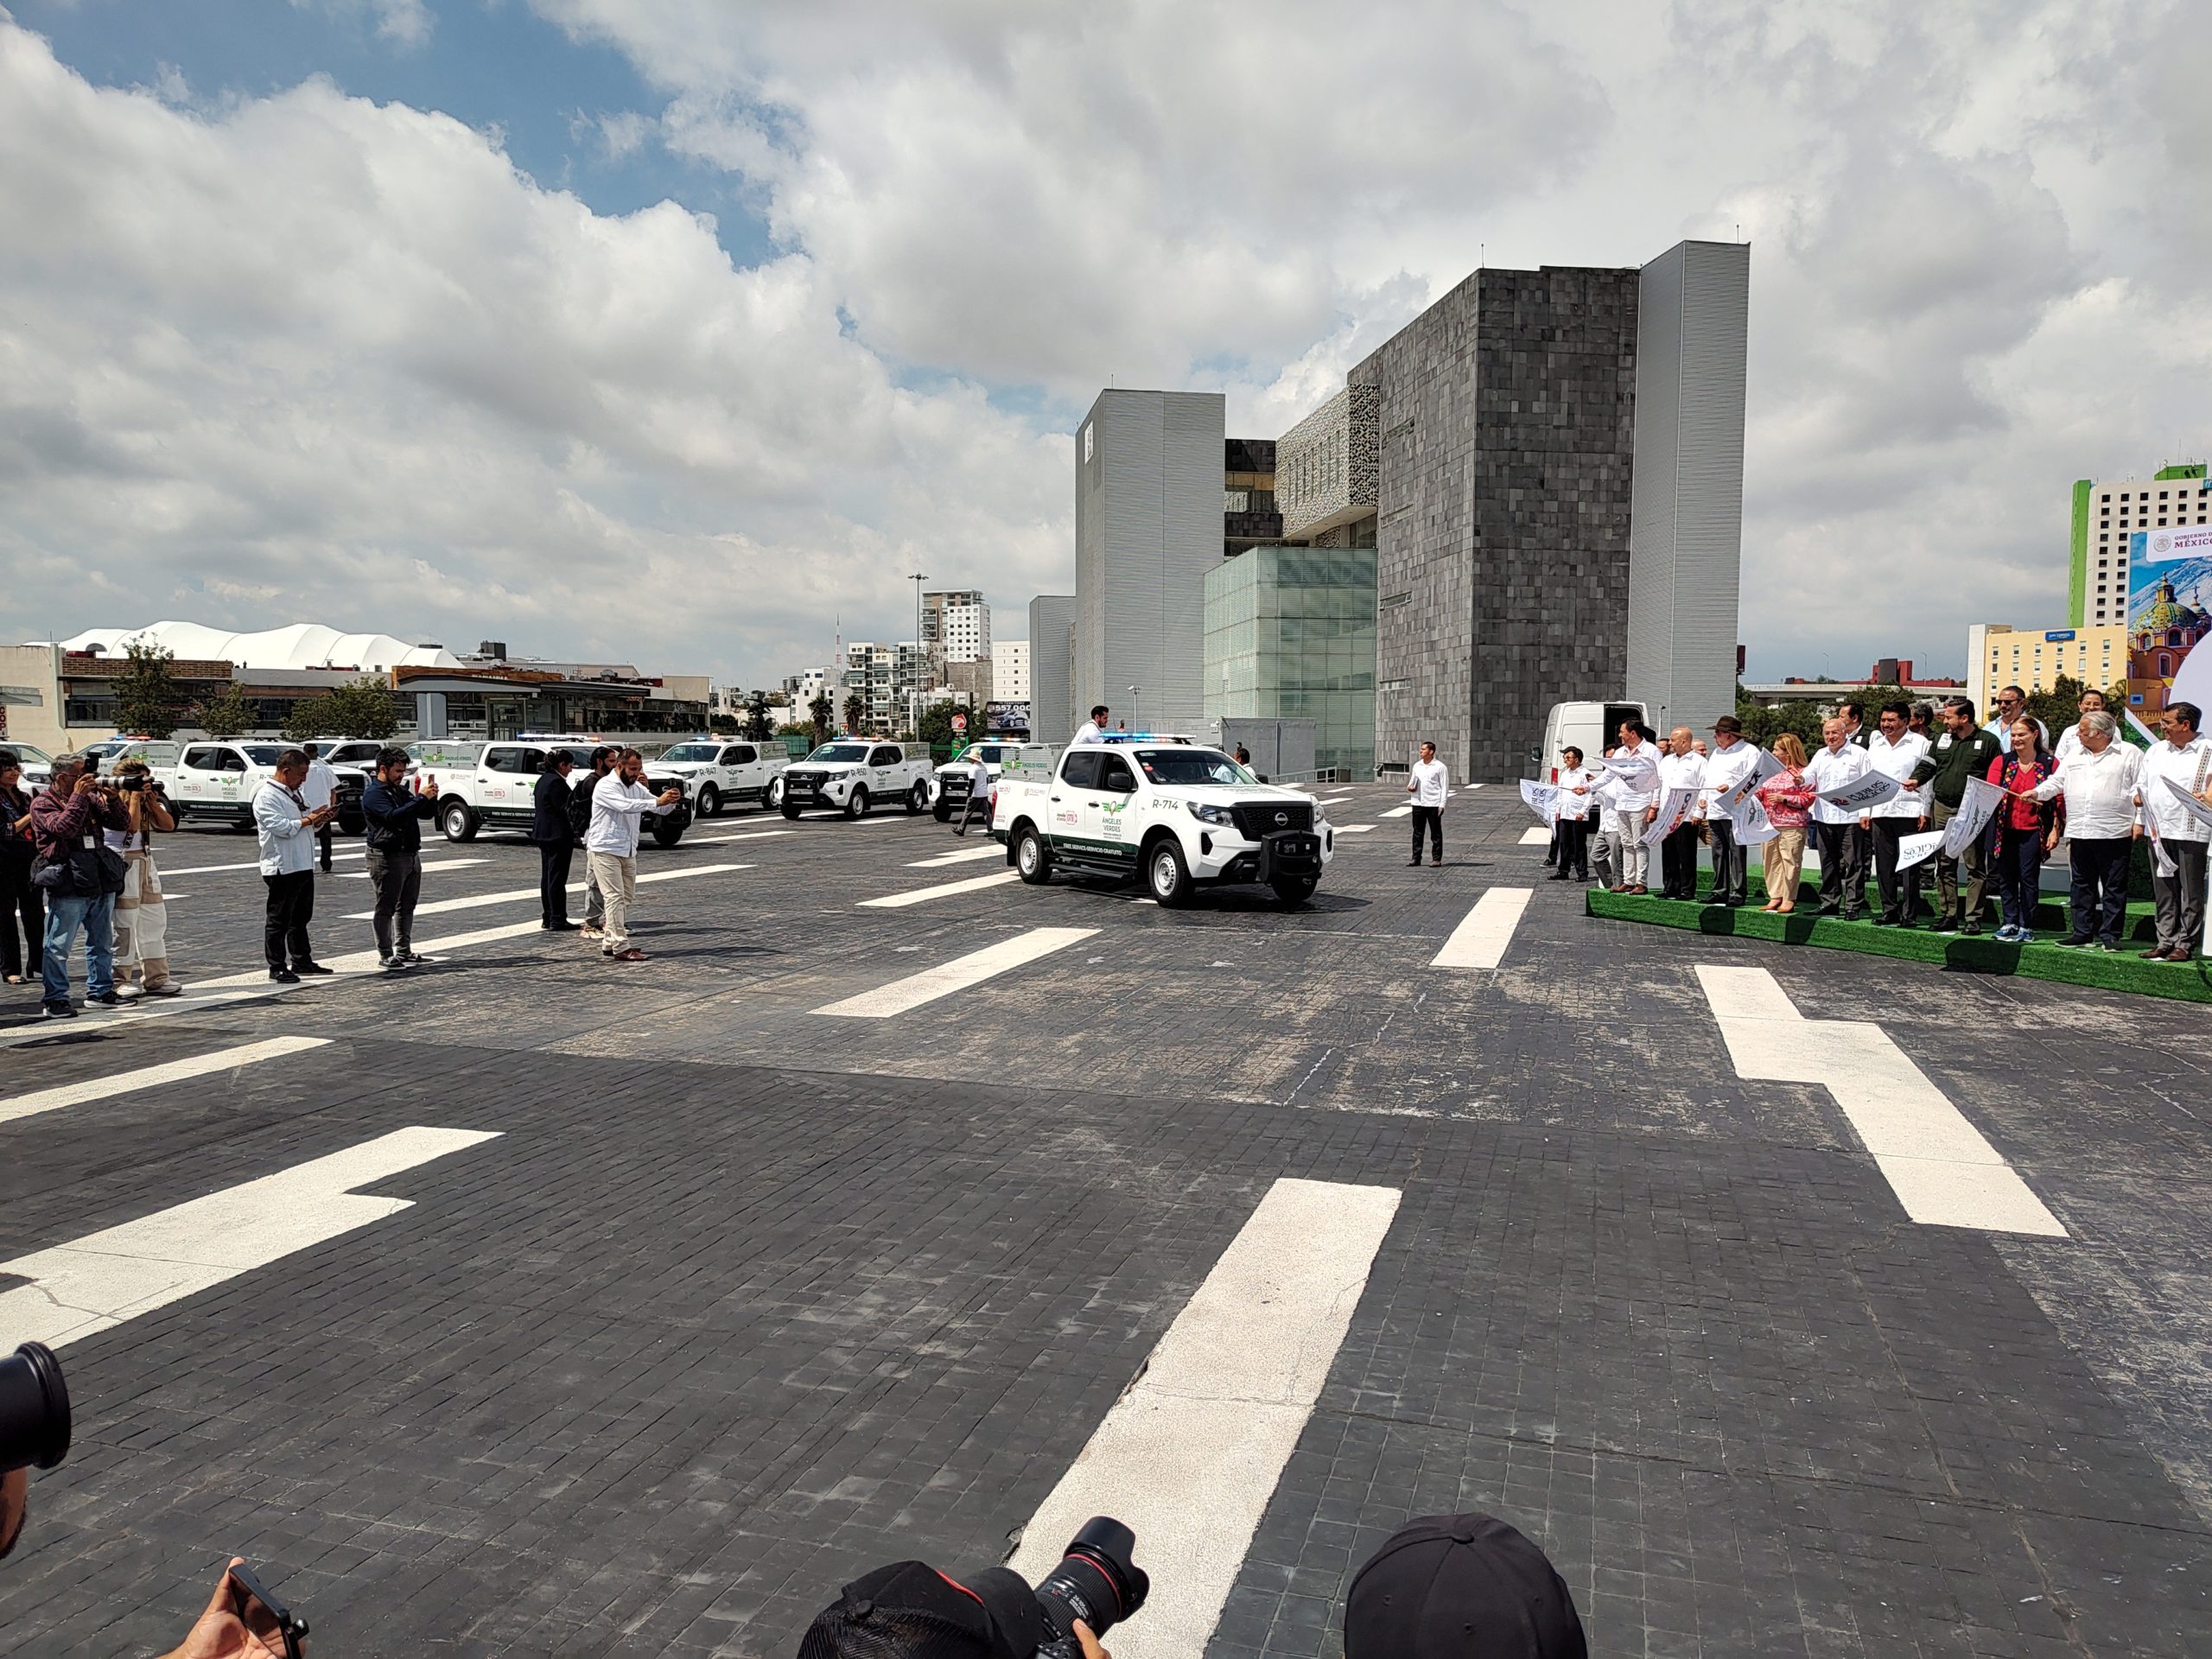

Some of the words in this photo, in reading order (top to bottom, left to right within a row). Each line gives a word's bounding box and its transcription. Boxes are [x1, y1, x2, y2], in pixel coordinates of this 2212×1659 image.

[2174, 532, 2207, 541] GOBIERNO
[1152, 799, 1179, 810] R-714
[1102, 817, 1122, 825] ÁNGELES
